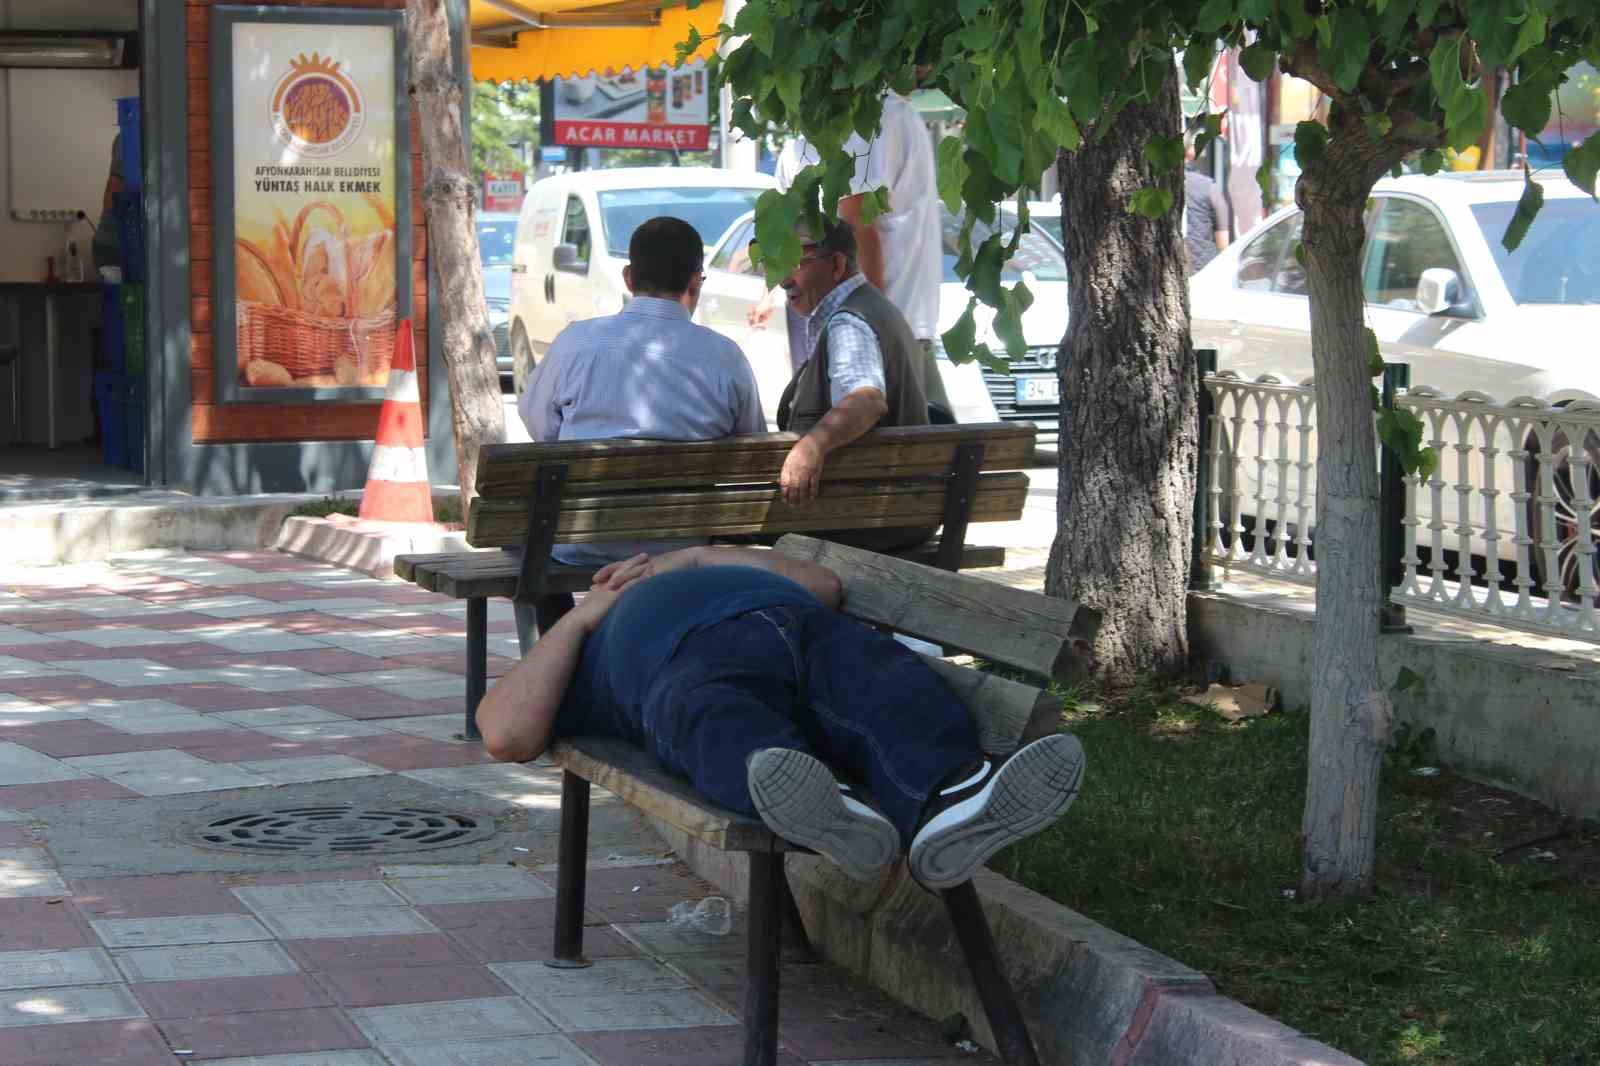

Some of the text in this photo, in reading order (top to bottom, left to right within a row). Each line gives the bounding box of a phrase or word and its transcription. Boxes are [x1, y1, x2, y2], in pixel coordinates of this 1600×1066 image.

[566, 125, 698, 144] ACAR MARKET
[255, 178, 382, 195] YÜNTAŞ HALK EKMEK
